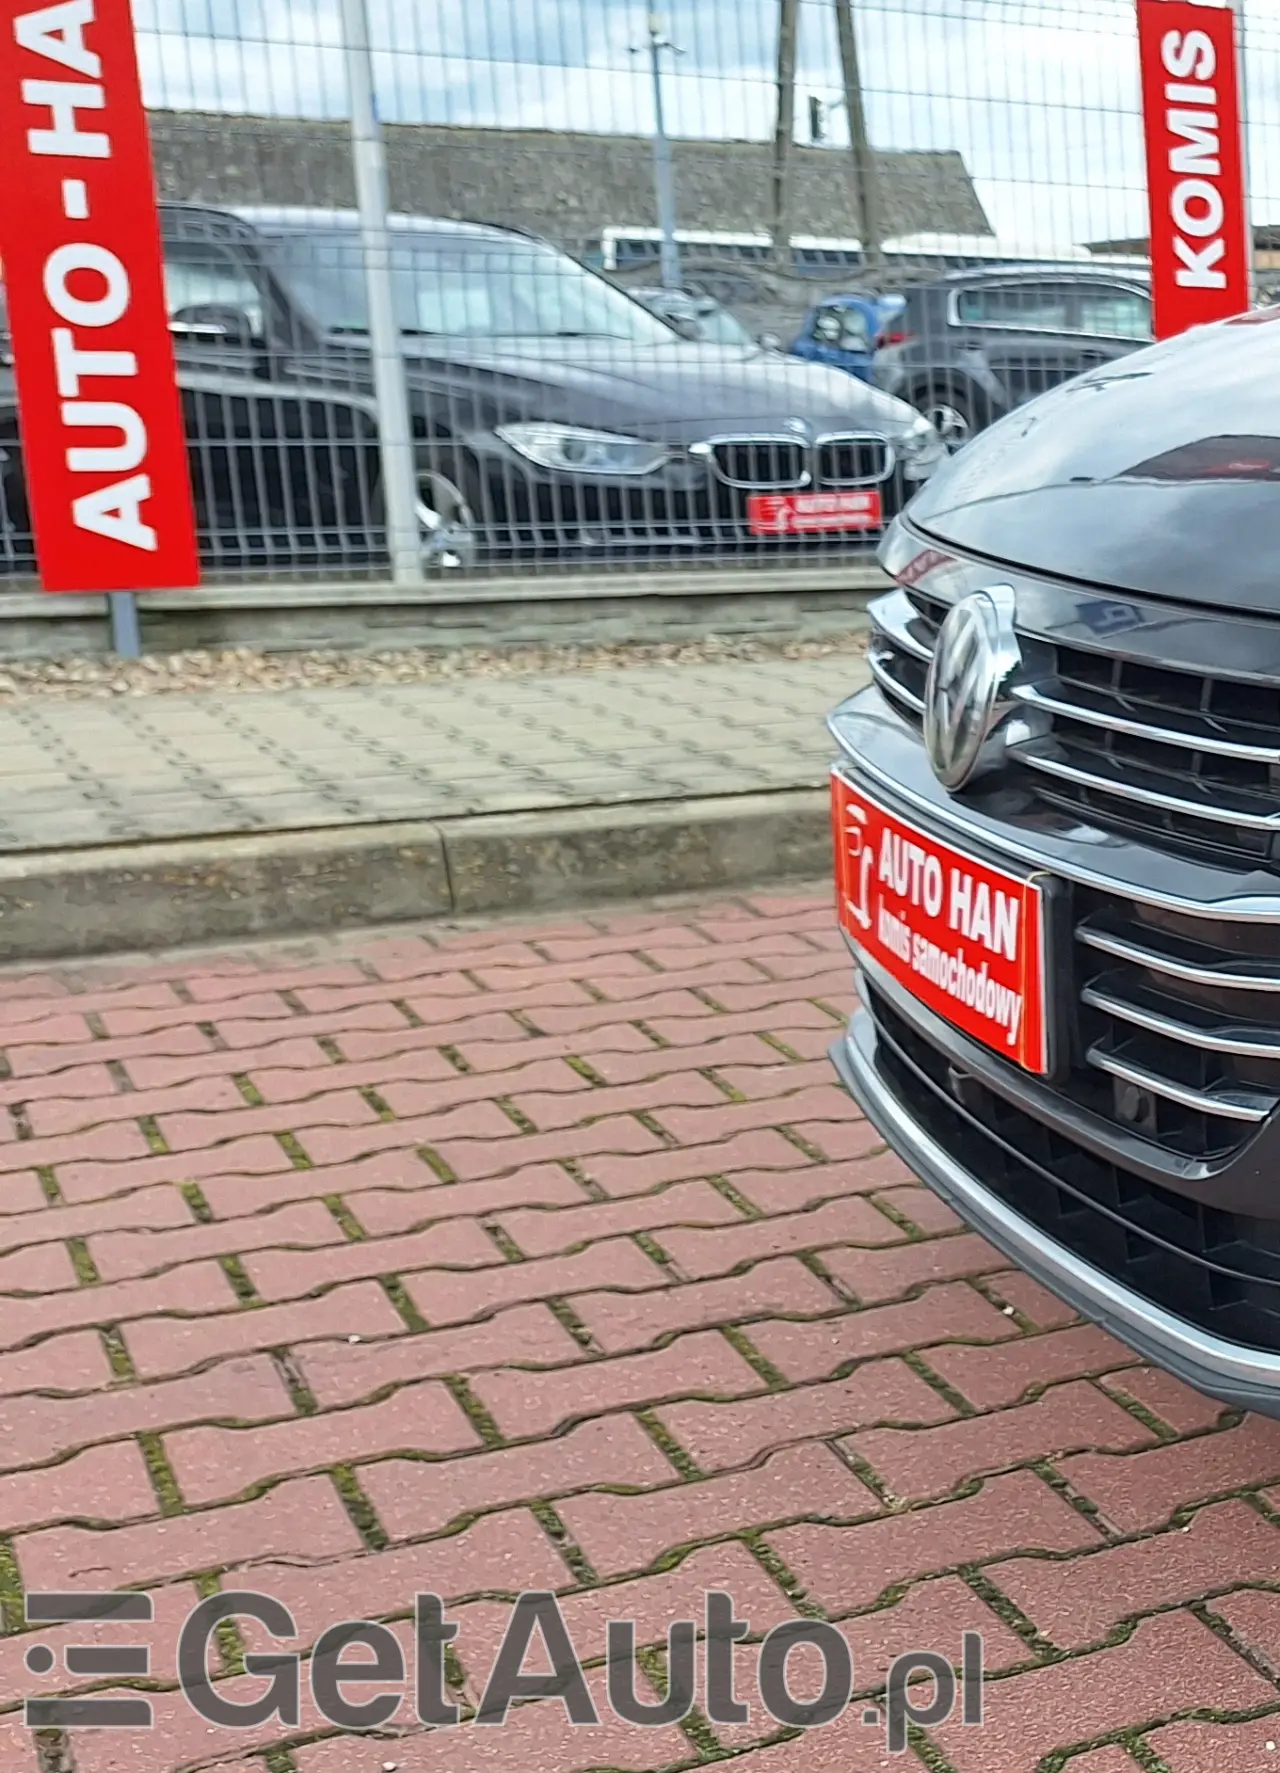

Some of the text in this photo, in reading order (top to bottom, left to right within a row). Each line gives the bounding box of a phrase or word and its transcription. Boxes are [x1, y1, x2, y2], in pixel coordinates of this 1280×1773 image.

[1160, 29, 1228, 289] KOMIS
[43, 242, 158, 551] AUTO
[878, 827, 1019, 962] AUTO HAN
[911, 932, 1022, 1046] samochodowy
